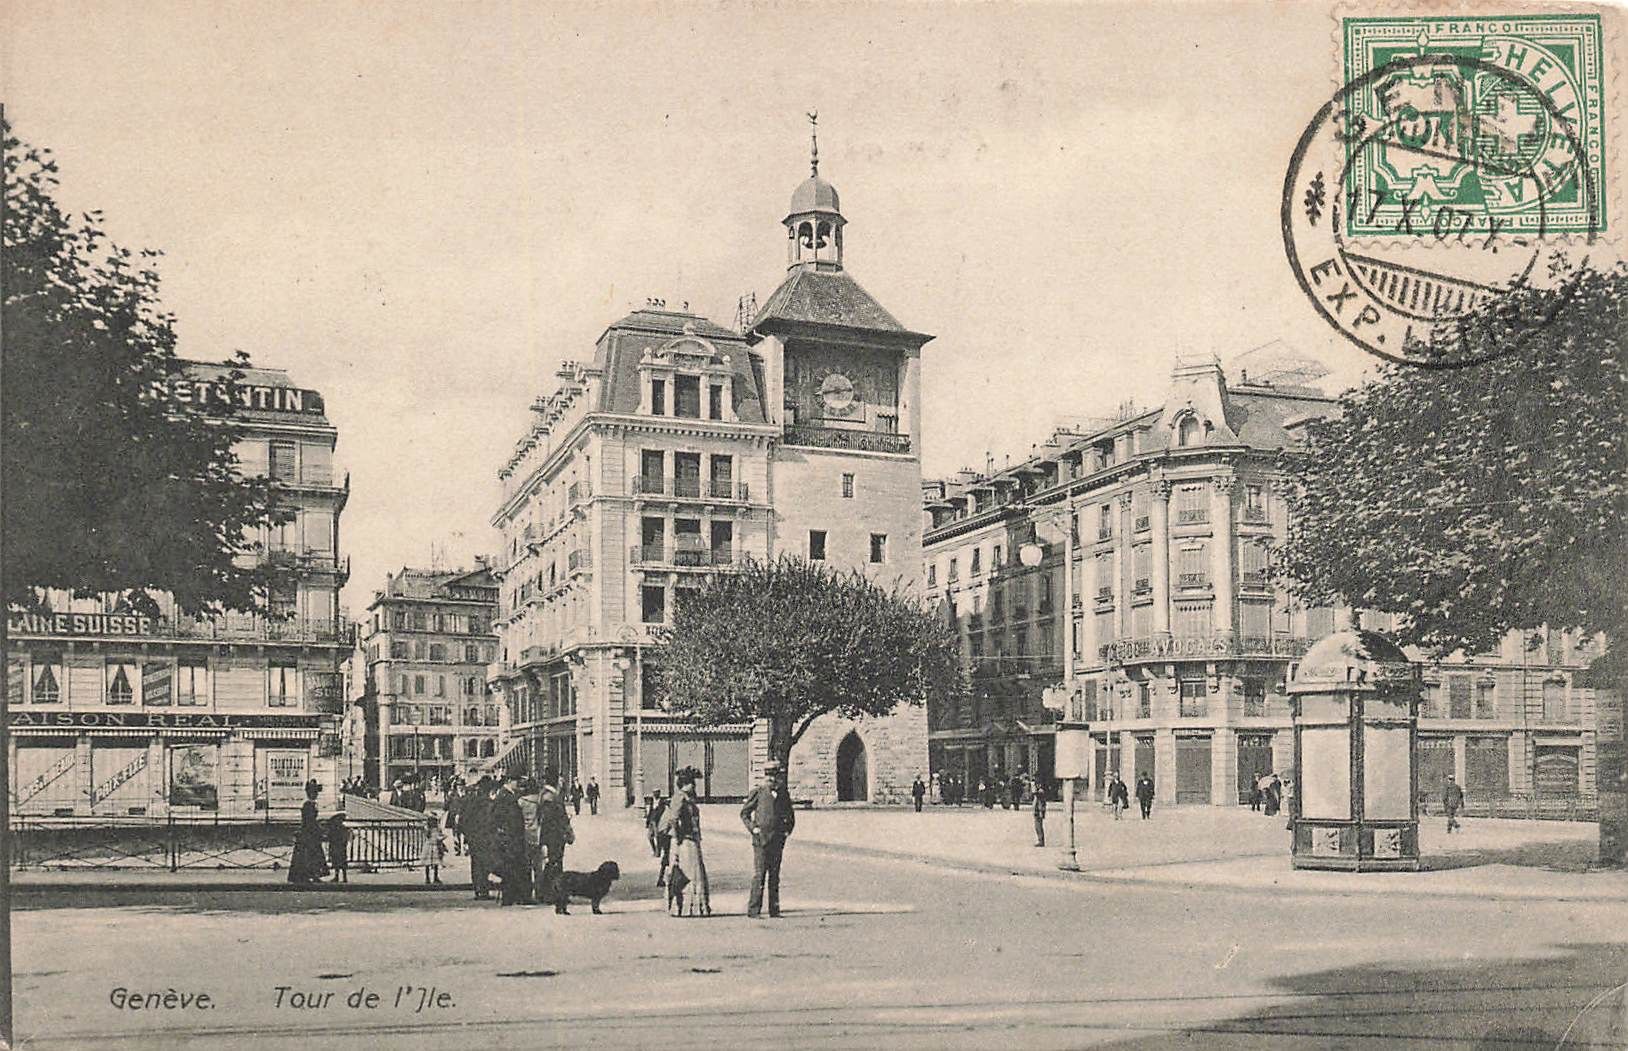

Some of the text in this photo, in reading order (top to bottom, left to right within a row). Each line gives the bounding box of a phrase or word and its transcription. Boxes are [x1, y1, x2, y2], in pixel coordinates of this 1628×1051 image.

[1434, 22, 1513, 34] FRANCO
[1588, 84, 1600, 165] FRANCO
[73, 614, 151, 636] SUISSE
